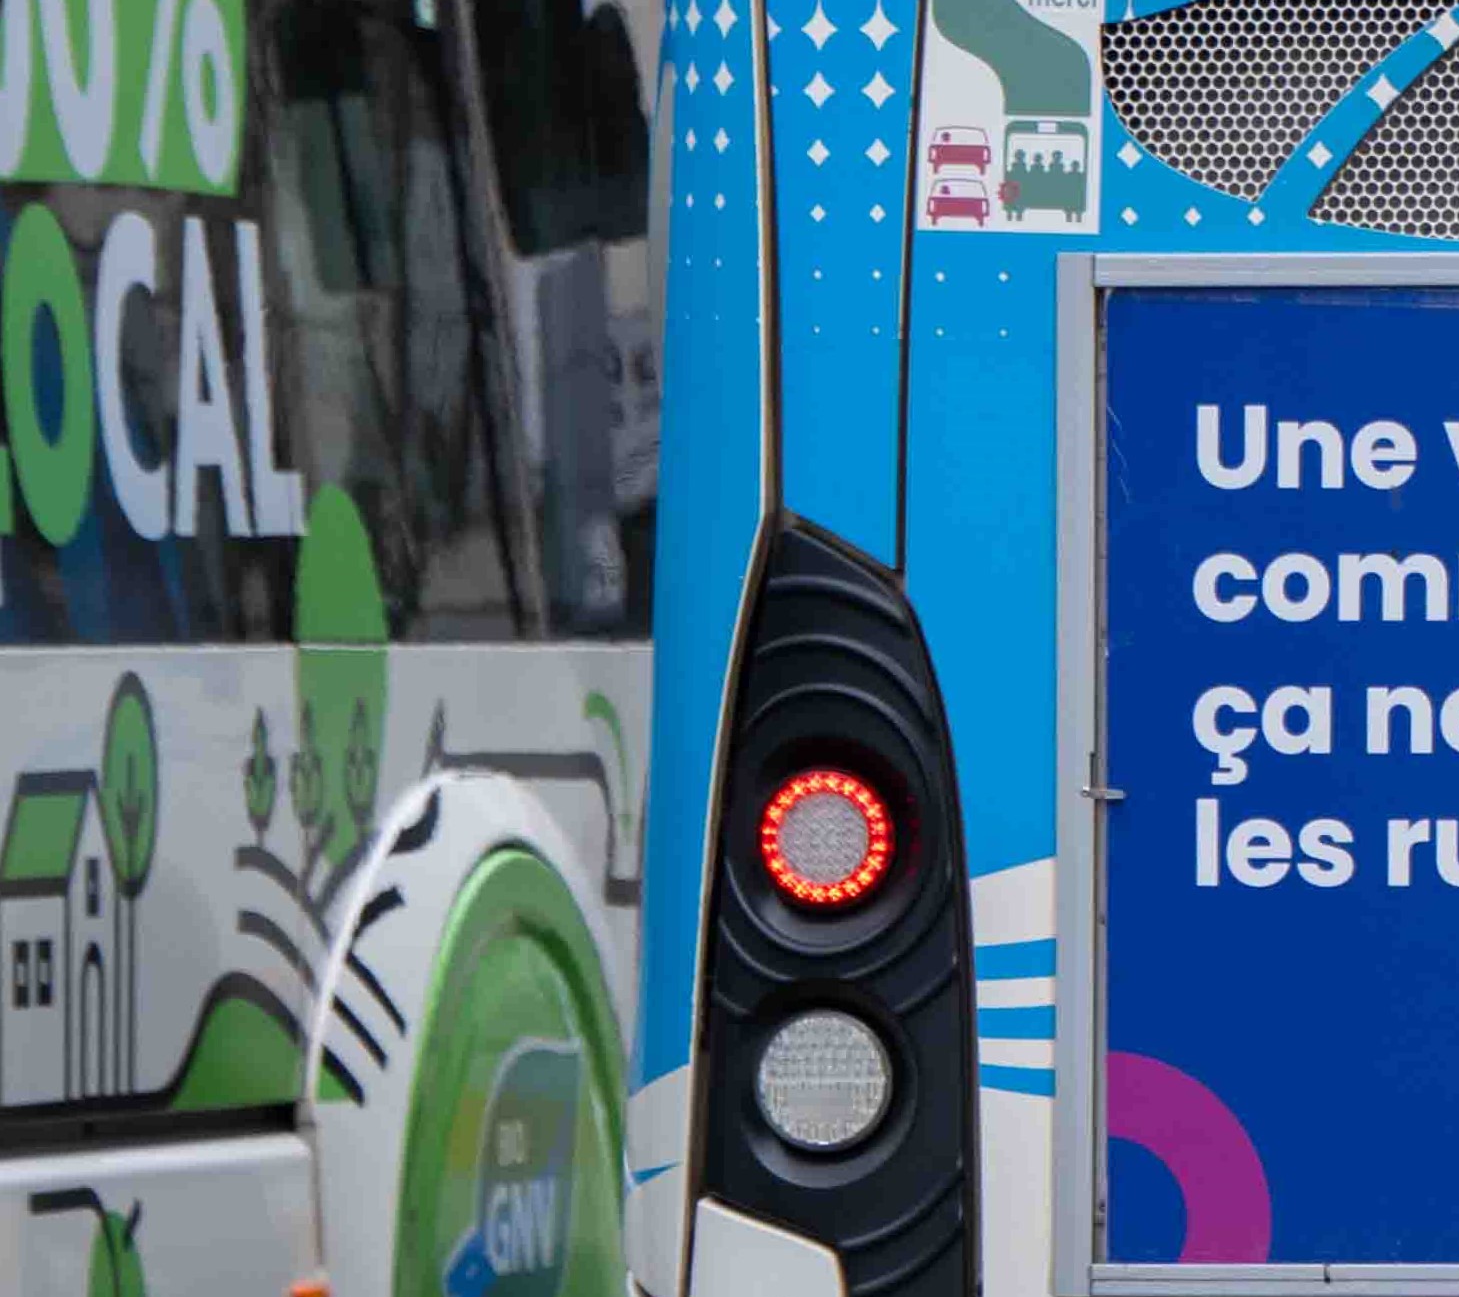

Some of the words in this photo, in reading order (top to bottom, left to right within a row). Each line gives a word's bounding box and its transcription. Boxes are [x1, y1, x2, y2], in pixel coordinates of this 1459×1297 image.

[0, 202, 309, 547] OCAL
[1196, 404, 1418, 490] Une
[1192, 685, 1332, 786] ça
[1196, 798, 1355, 888] les
